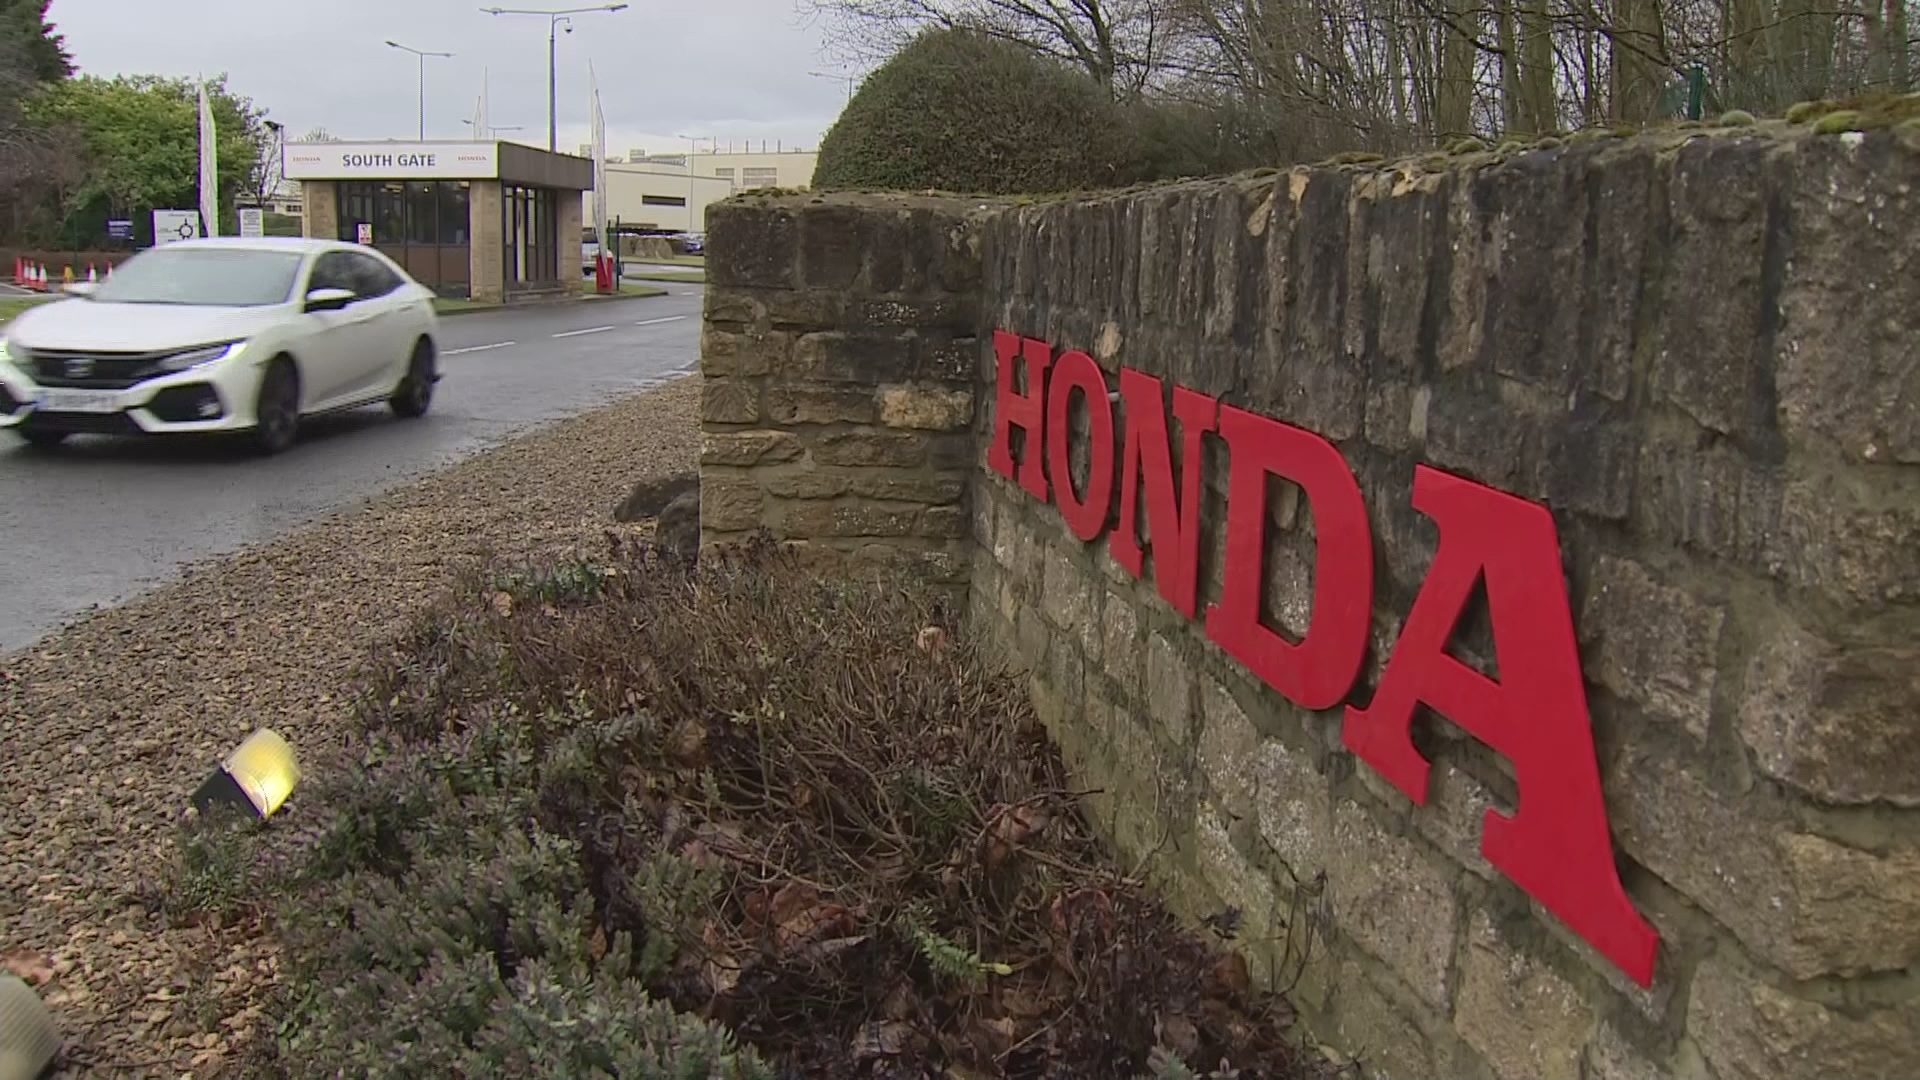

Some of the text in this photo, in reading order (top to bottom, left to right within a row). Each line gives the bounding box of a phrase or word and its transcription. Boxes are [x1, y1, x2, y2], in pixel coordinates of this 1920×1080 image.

[342, 154, 436, 167] SOUTH GATE
[987, 329, 1660, 990] HONDA
